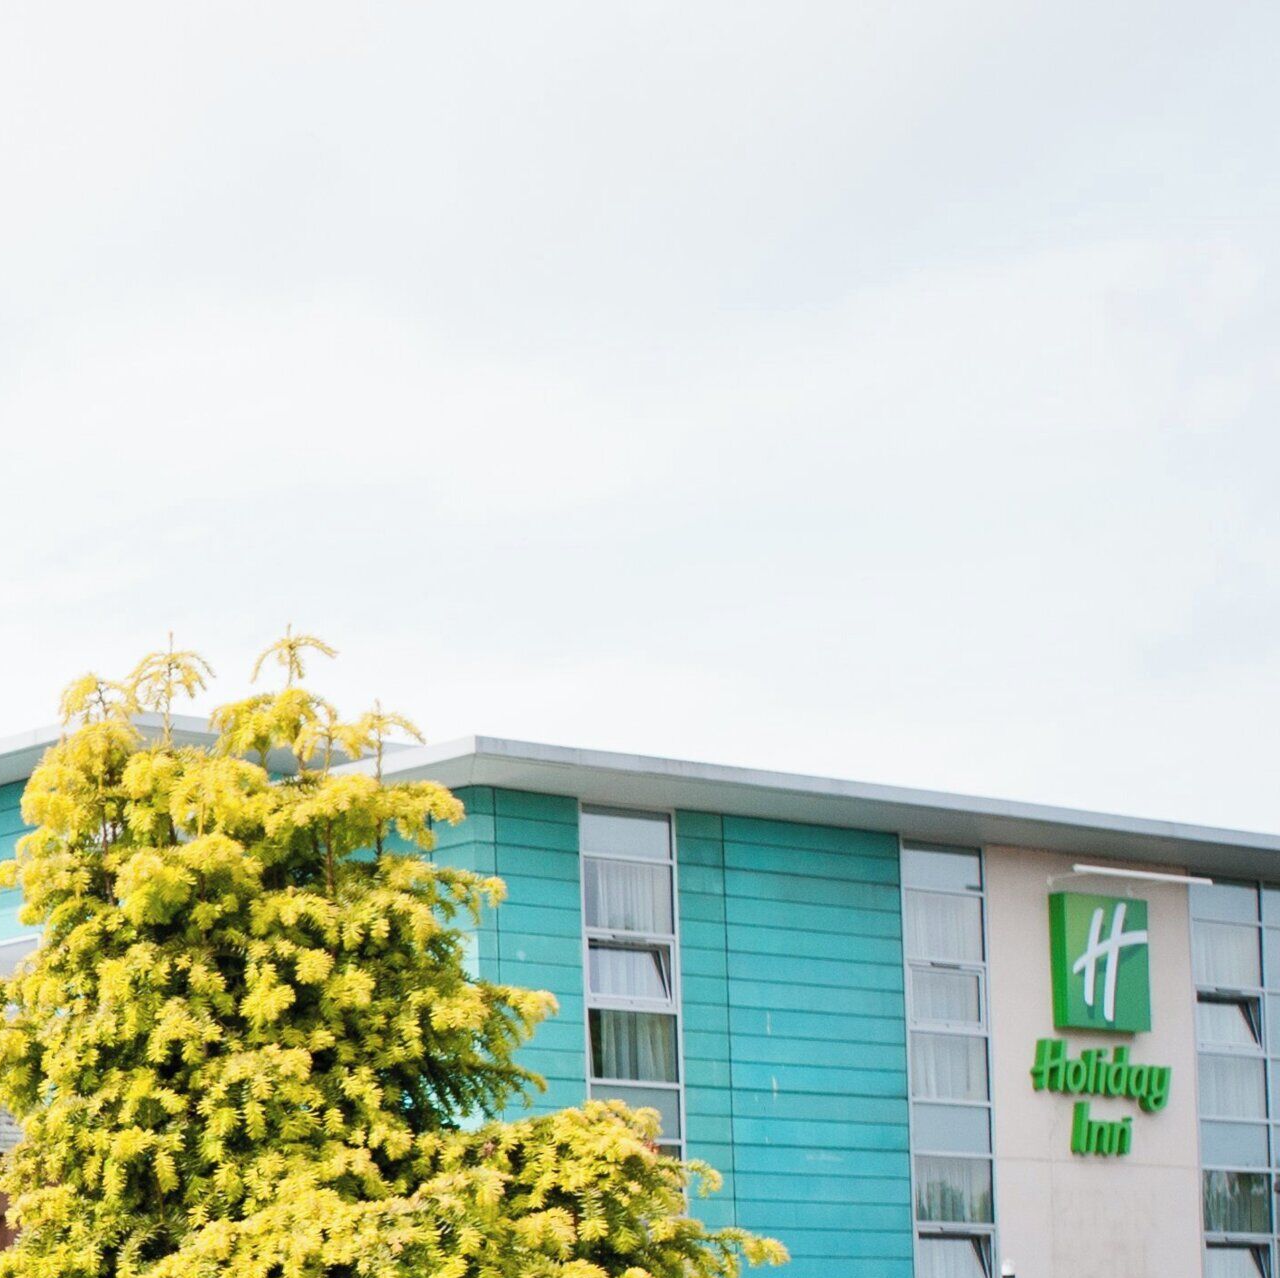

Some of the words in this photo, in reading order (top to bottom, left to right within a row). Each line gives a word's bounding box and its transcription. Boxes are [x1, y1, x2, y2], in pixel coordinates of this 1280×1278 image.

[1072, 902, 1148, 1022] H
[1030, 1038, 1172, 1112] Holiday
[1070, 1099, 1133, 1156] Inn
